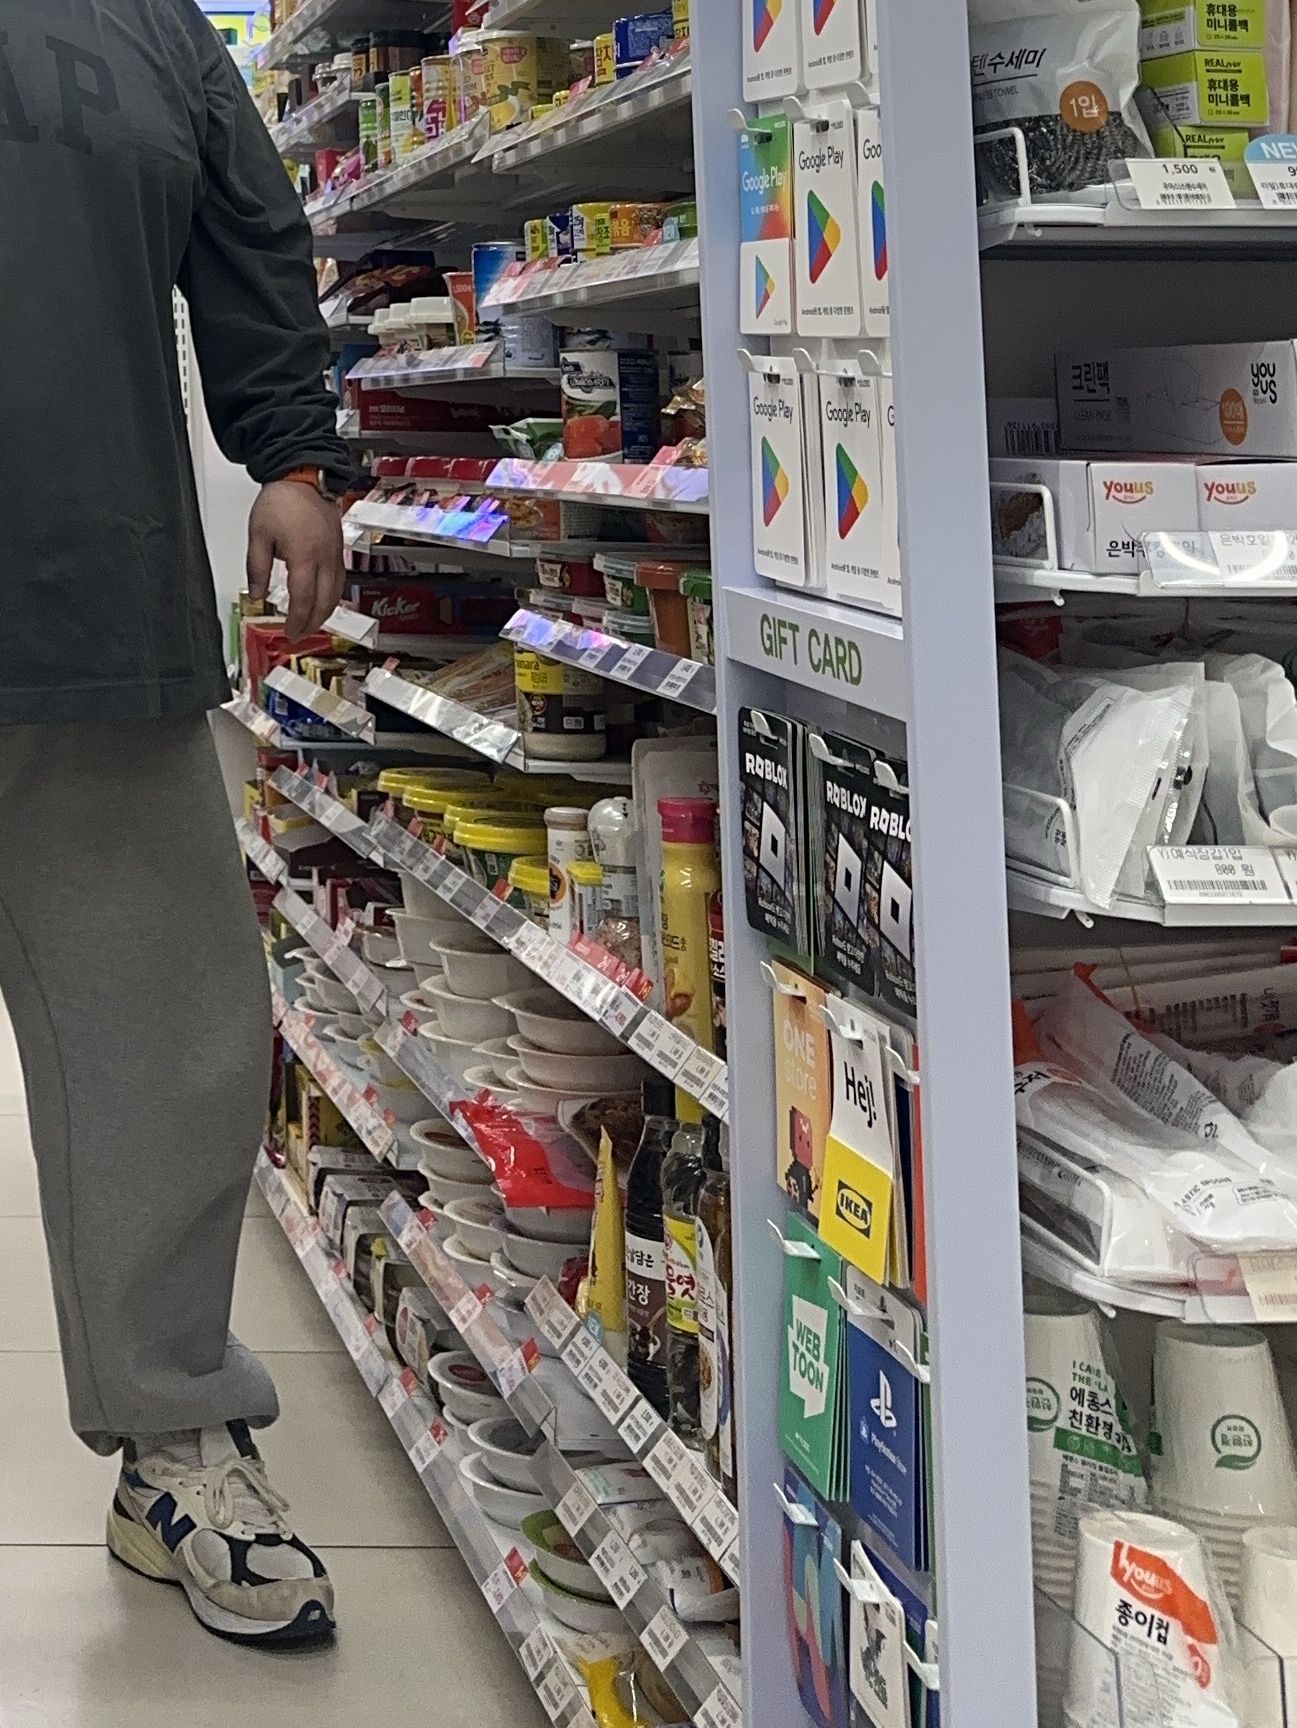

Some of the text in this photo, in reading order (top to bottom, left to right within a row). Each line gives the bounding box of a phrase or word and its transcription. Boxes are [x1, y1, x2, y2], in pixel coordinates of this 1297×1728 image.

[1206, 3, 1237, 17] 휴대용
[1205, 59, 1226, 68] REAL
[1208, 79, 1239, 92] 휴대용
[1069, 94, 1100, 119] 1입
[1186, 134, 1208, 144] REAL
[799, 145, 844, 173] Google Play
[1162, 164, 1198, 176] 1,500
[742, 166, 788, 195] Google Play
[754, 396, 794, 424] Google Play
[826, 401, 871, 428] Google Play
[1103, 480, 1154, 501] youus
[1204, 480, 1257, 502] youus
[760, 612, 863, 687] GIFT CARD
[745, 752, 789, 790] ROBLOX
[826, 780, 867, 819] ROBLOX
[1241, 863, 1255, 877] 원
[783, 1018, 816, 1069] ONE
[843, 1060, 877, 1129] Hej!
[839, 1192, 869, 1227] IKEA
[795, 1318, 821, 1360] WEB
[791, 1344, 825, 1393] TOON
[146, 1491, 196, 1554] N
[1115, 1598, 1171, 1646] 종이컵
